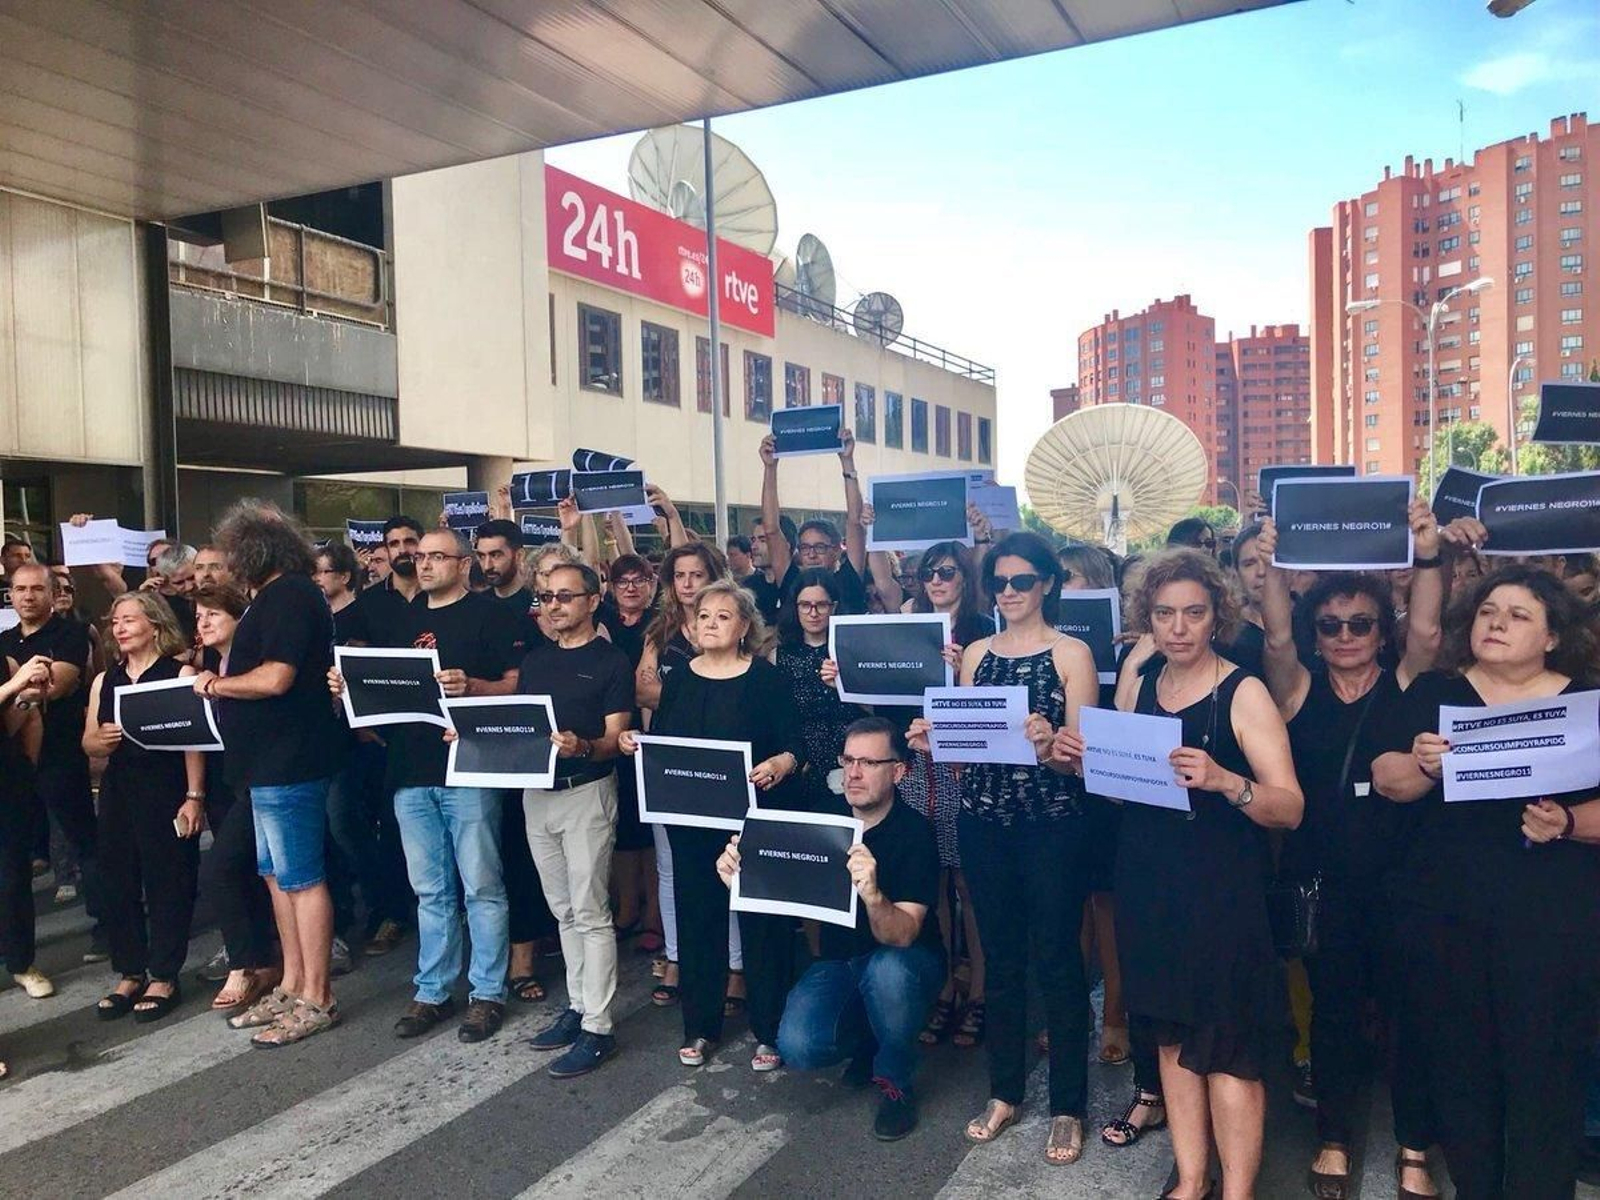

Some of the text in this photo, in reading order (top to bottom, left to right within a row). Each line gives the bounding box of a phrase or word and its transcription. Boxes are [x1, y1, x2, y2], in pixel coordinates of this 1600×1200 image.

[561, 191, 641, 280] 24h
[685, 269, 701, 287] 24h
[725, 271, 758, 314] rtve
[1495, 499, 1600, 512] #VIERNES NEGRO11#
[1291, 522, 1392, 531] #VIERNES NEGRO11#
[888, 661, 923, 669] NEGRO11#
[985, 700, 991, 708] ES
[1453, 721, 1481, 731] #RTVE
[1483, 719, 1496, 727] NO
[1544, 709, 1567, 718] TUYA
[664, 768, 727, 781] #VIERNES NEGRO11#
[1456, 767, 1532, 780] #VIERNESNEGRO11
[759, 849, 829, 863] #VIERNES NEGRO11#
